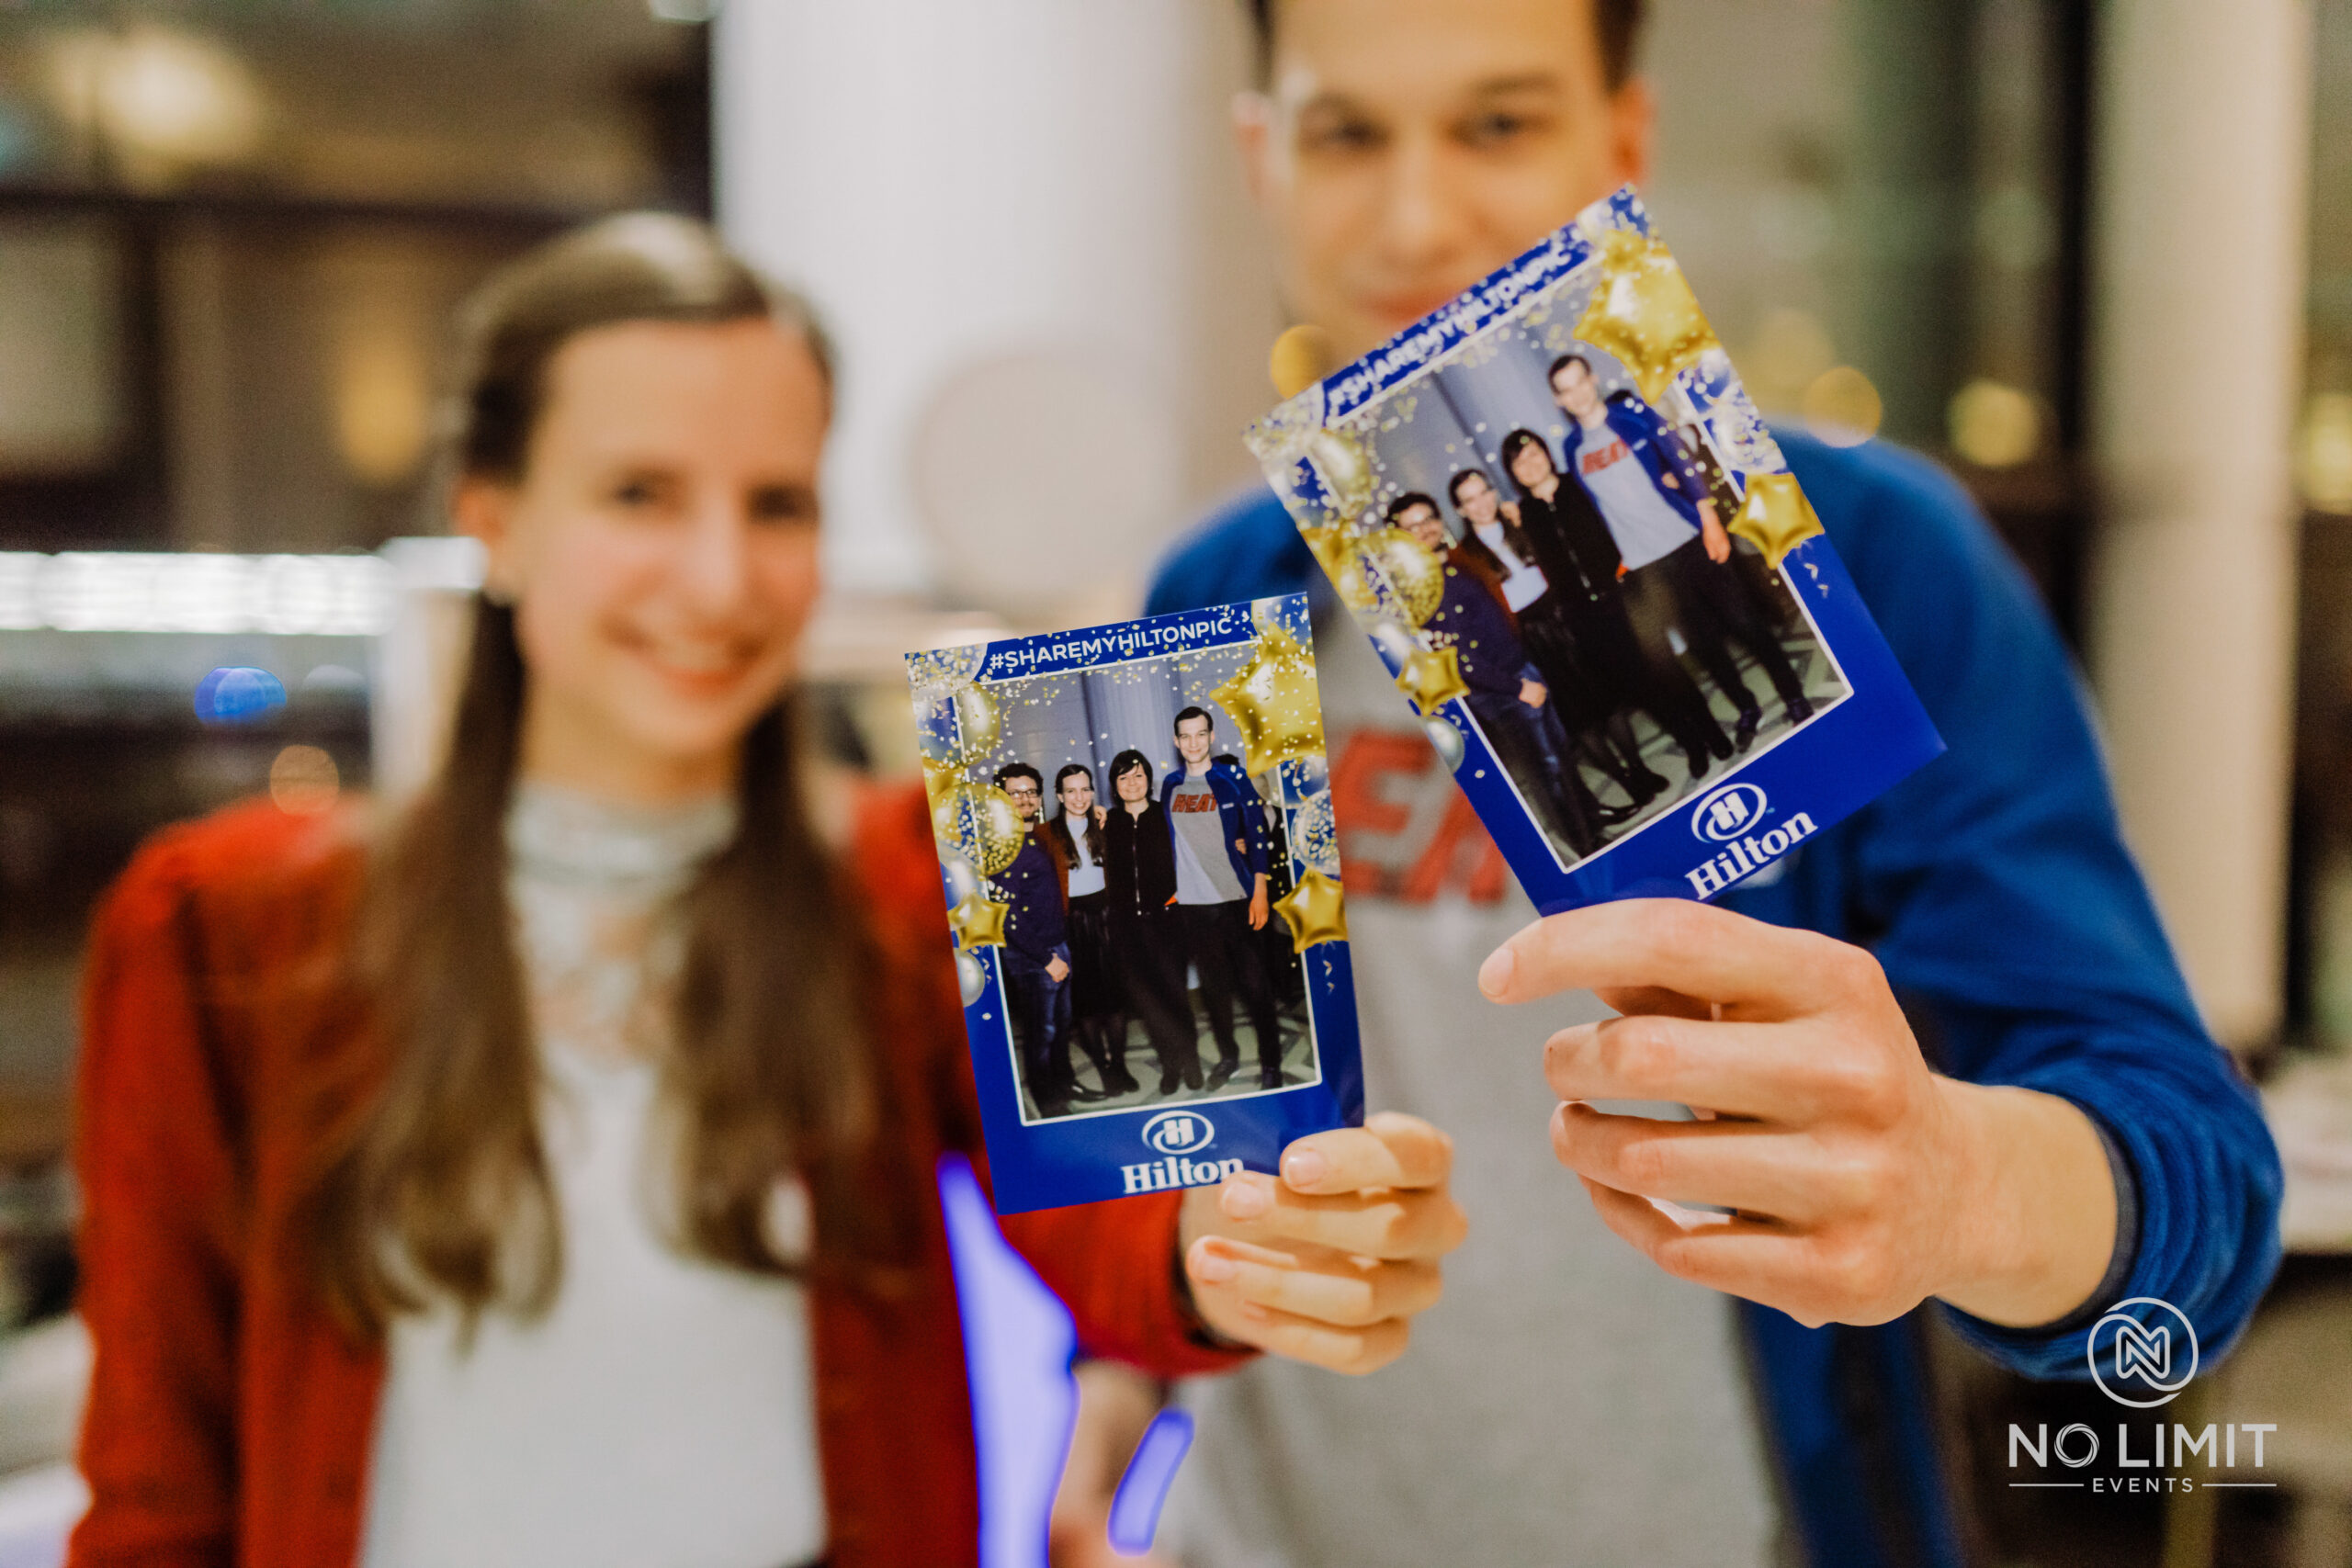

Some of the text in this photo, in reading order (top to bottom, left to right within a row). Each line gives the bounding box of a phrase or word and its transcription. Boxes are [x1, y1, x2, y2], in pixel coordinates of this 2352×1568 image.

[1329, 242, 1571, 406] #SHAREMYHILTONPIC
[989, 617, 1233, 670] #SHAREMYHILTONPIC
[1684, 812, 1818, 901] Hilton
[1121, 1156, 1245, 1194] Hilton
